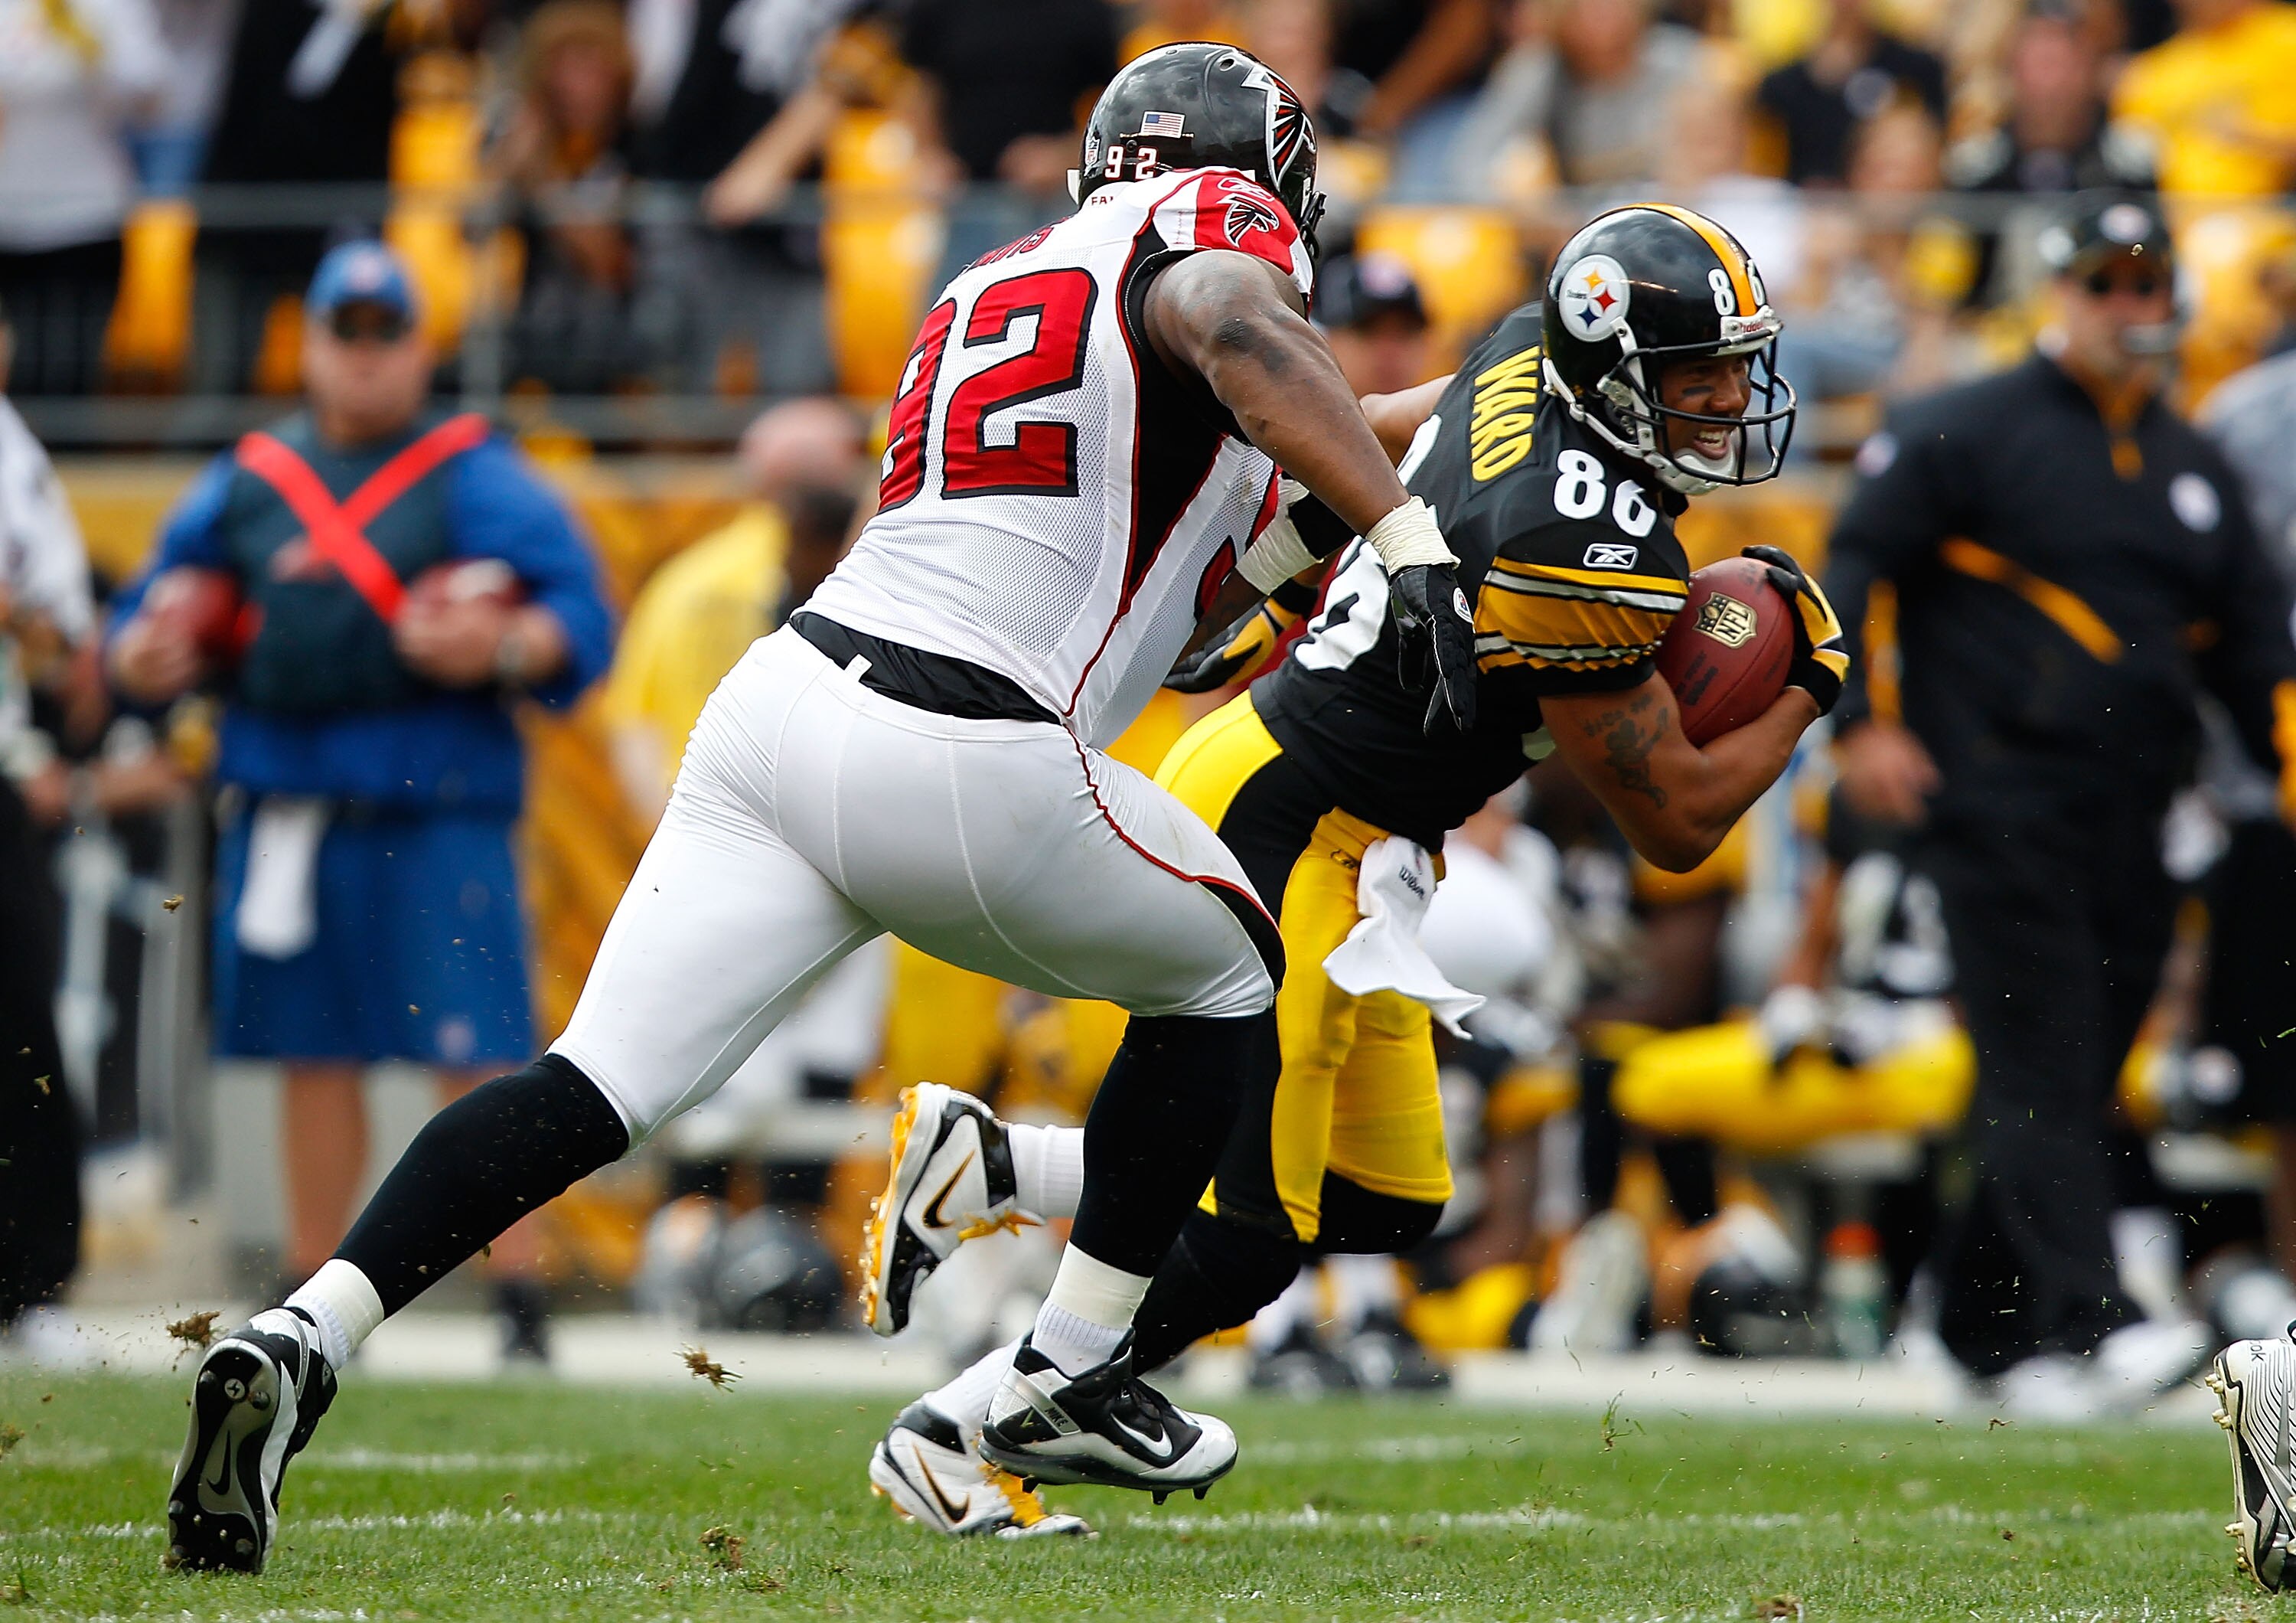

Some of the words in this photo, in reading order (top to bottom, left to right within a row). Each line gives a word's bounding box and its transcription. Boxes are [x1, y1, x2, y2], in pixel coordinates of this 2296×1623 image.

[1103, 144, 1159, 181] 92
[1707, 259, 1766, 316] 86
[877, 266, 1099, 515] 92
[1471, 345, 1541, 482] WARD
[1554, 449, 1658, 538] 86
[1716, 608, 1751, 642] NFL
